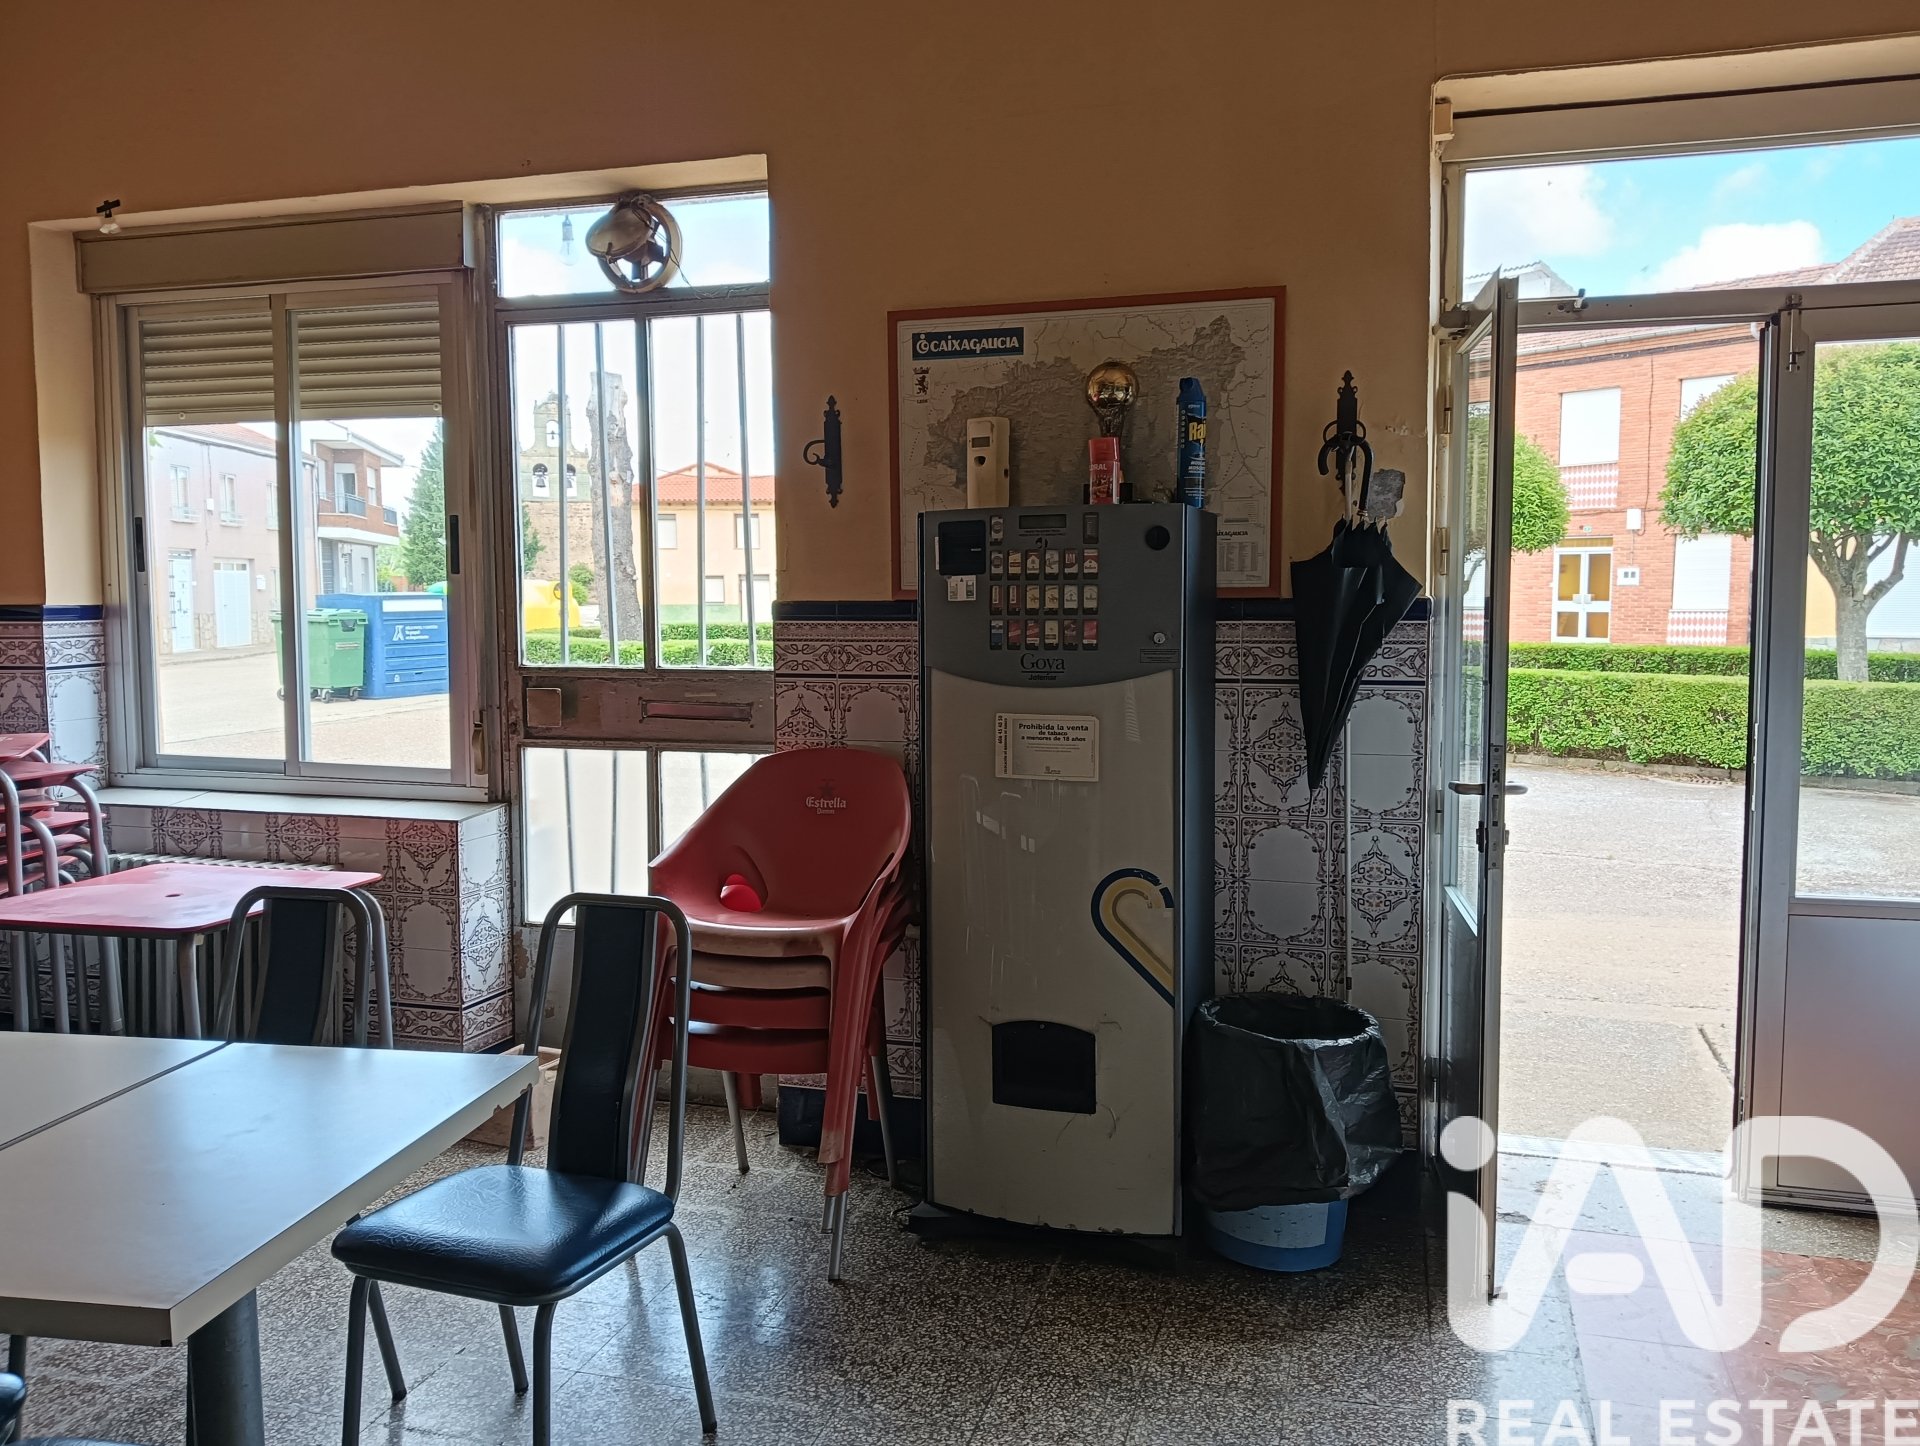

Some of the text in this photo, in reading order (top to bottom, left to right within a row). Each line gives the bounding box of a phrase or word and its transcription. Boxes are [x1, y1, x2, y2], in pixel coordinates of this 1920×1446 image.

[1188, 421, 1206, 441] Rai
[1020, 652, 1066, 671] Goya
[1019, 723, 1055, 731] Prohibida
[805, 796, 847, 808] Estrella
